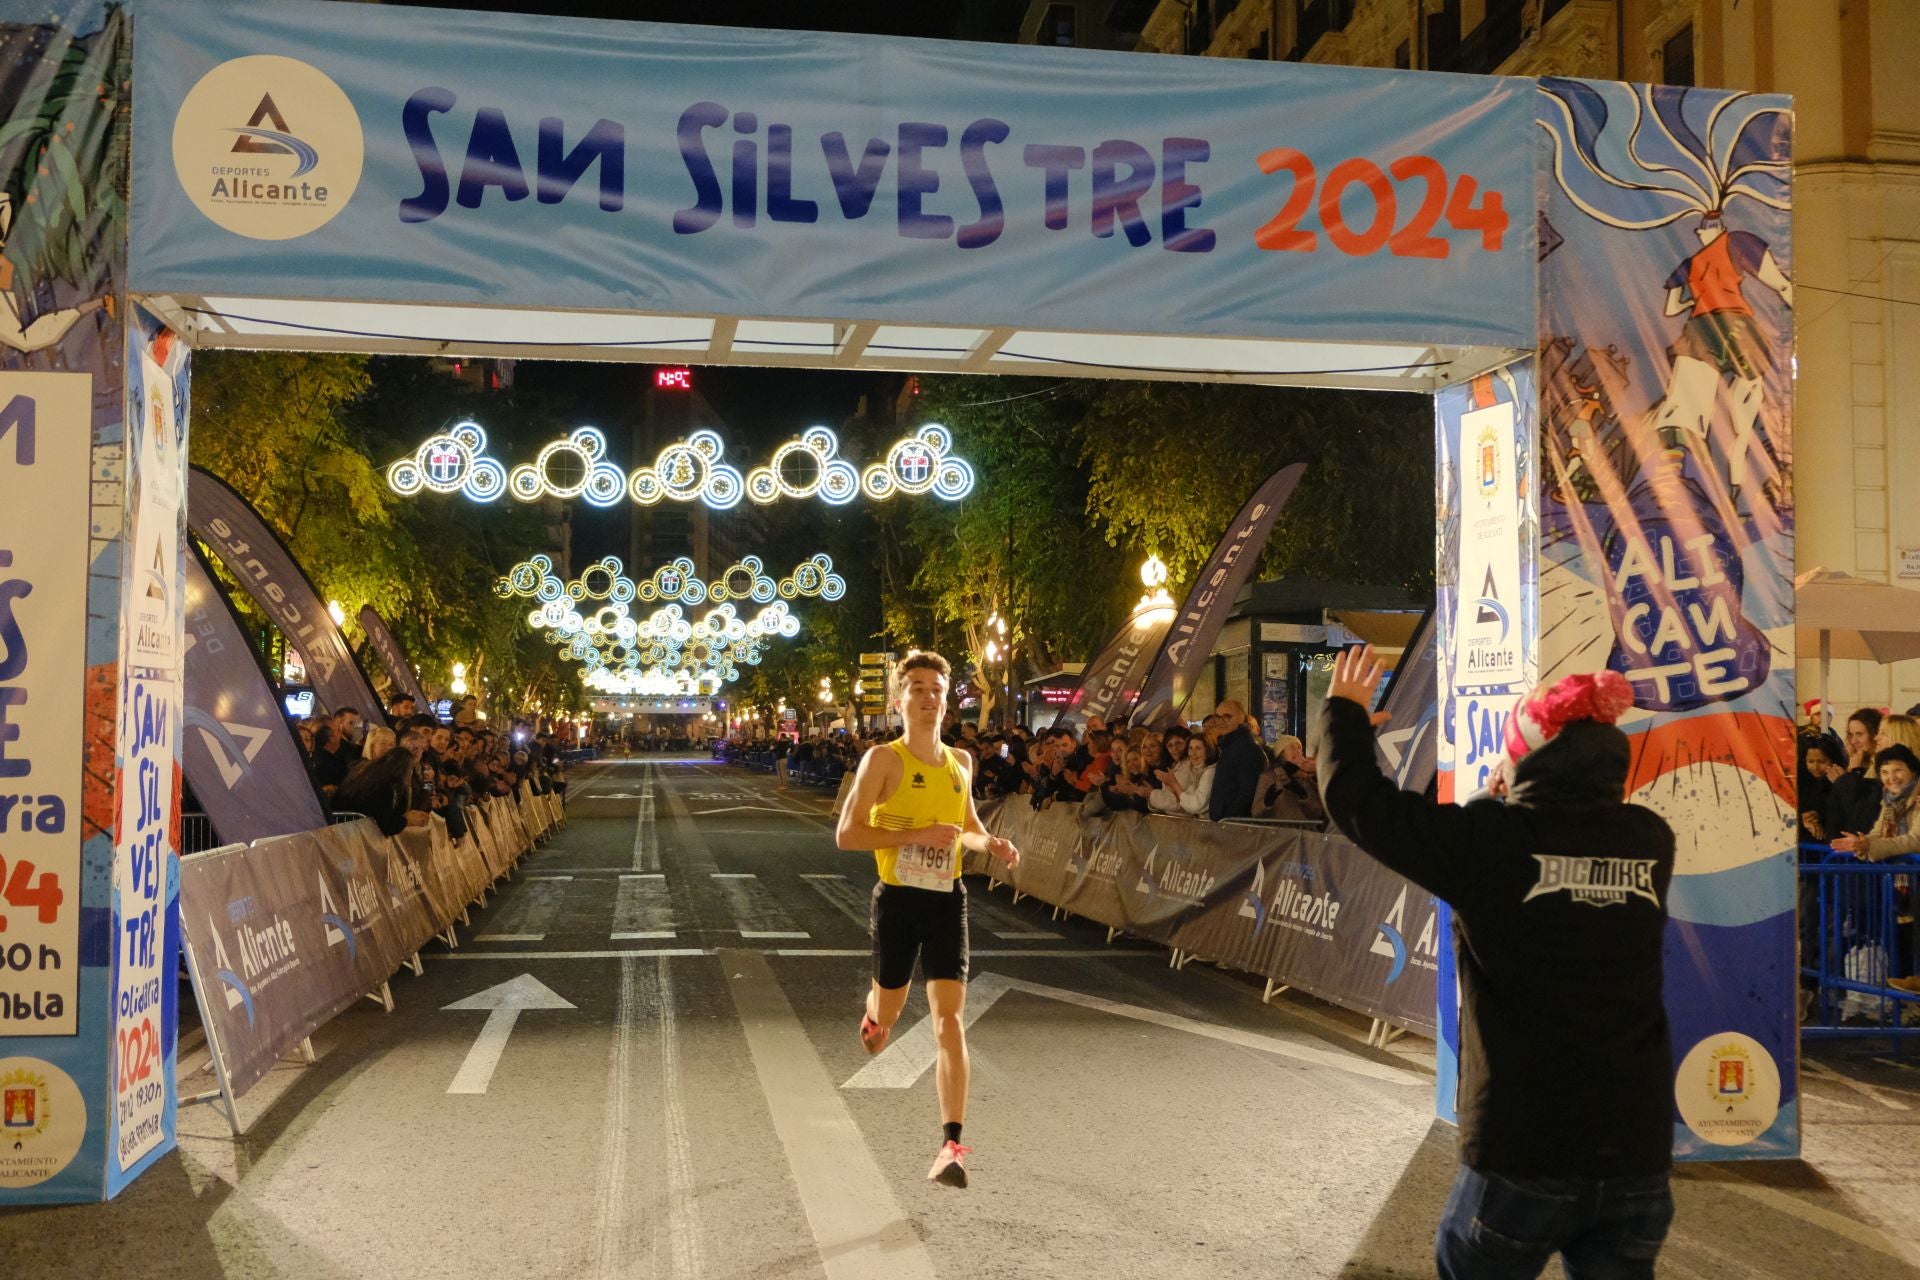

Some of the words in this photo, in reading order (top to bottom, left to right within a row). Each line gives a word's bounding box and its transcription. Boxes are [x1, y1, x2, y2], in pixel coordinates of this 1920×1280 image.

[211, 166, 270, 177] DEPORTES
[211, 177, 328, 201] Alicante
[399, 85, 625, 223] SAN
[1254, 147, 1508, 259] 2024
[1167, 503, 1266, 665] Alicante
[1615, 533, 1726, 594] ALI
[1622, 596, 1737, 656] CAN
[1467, 649, 1514, 669] Alicante
[1625, 648, 1749, 704] TE
[131, 682, 167, 758] SAN
[131, 828, 163, 902] VES
[919, 845, 951, 871] 1961
[1159, 859, 1215, 898] Alicante
[1270, 879, 1340, 930] Alicante
[126, 904, 158, 969] TRE
[119, 976, 160, 1021] olidaria
[118, 1017, 160, 1094] 2024
[1697, 1119, 1762, 1128] AYUNTAMIENTO
